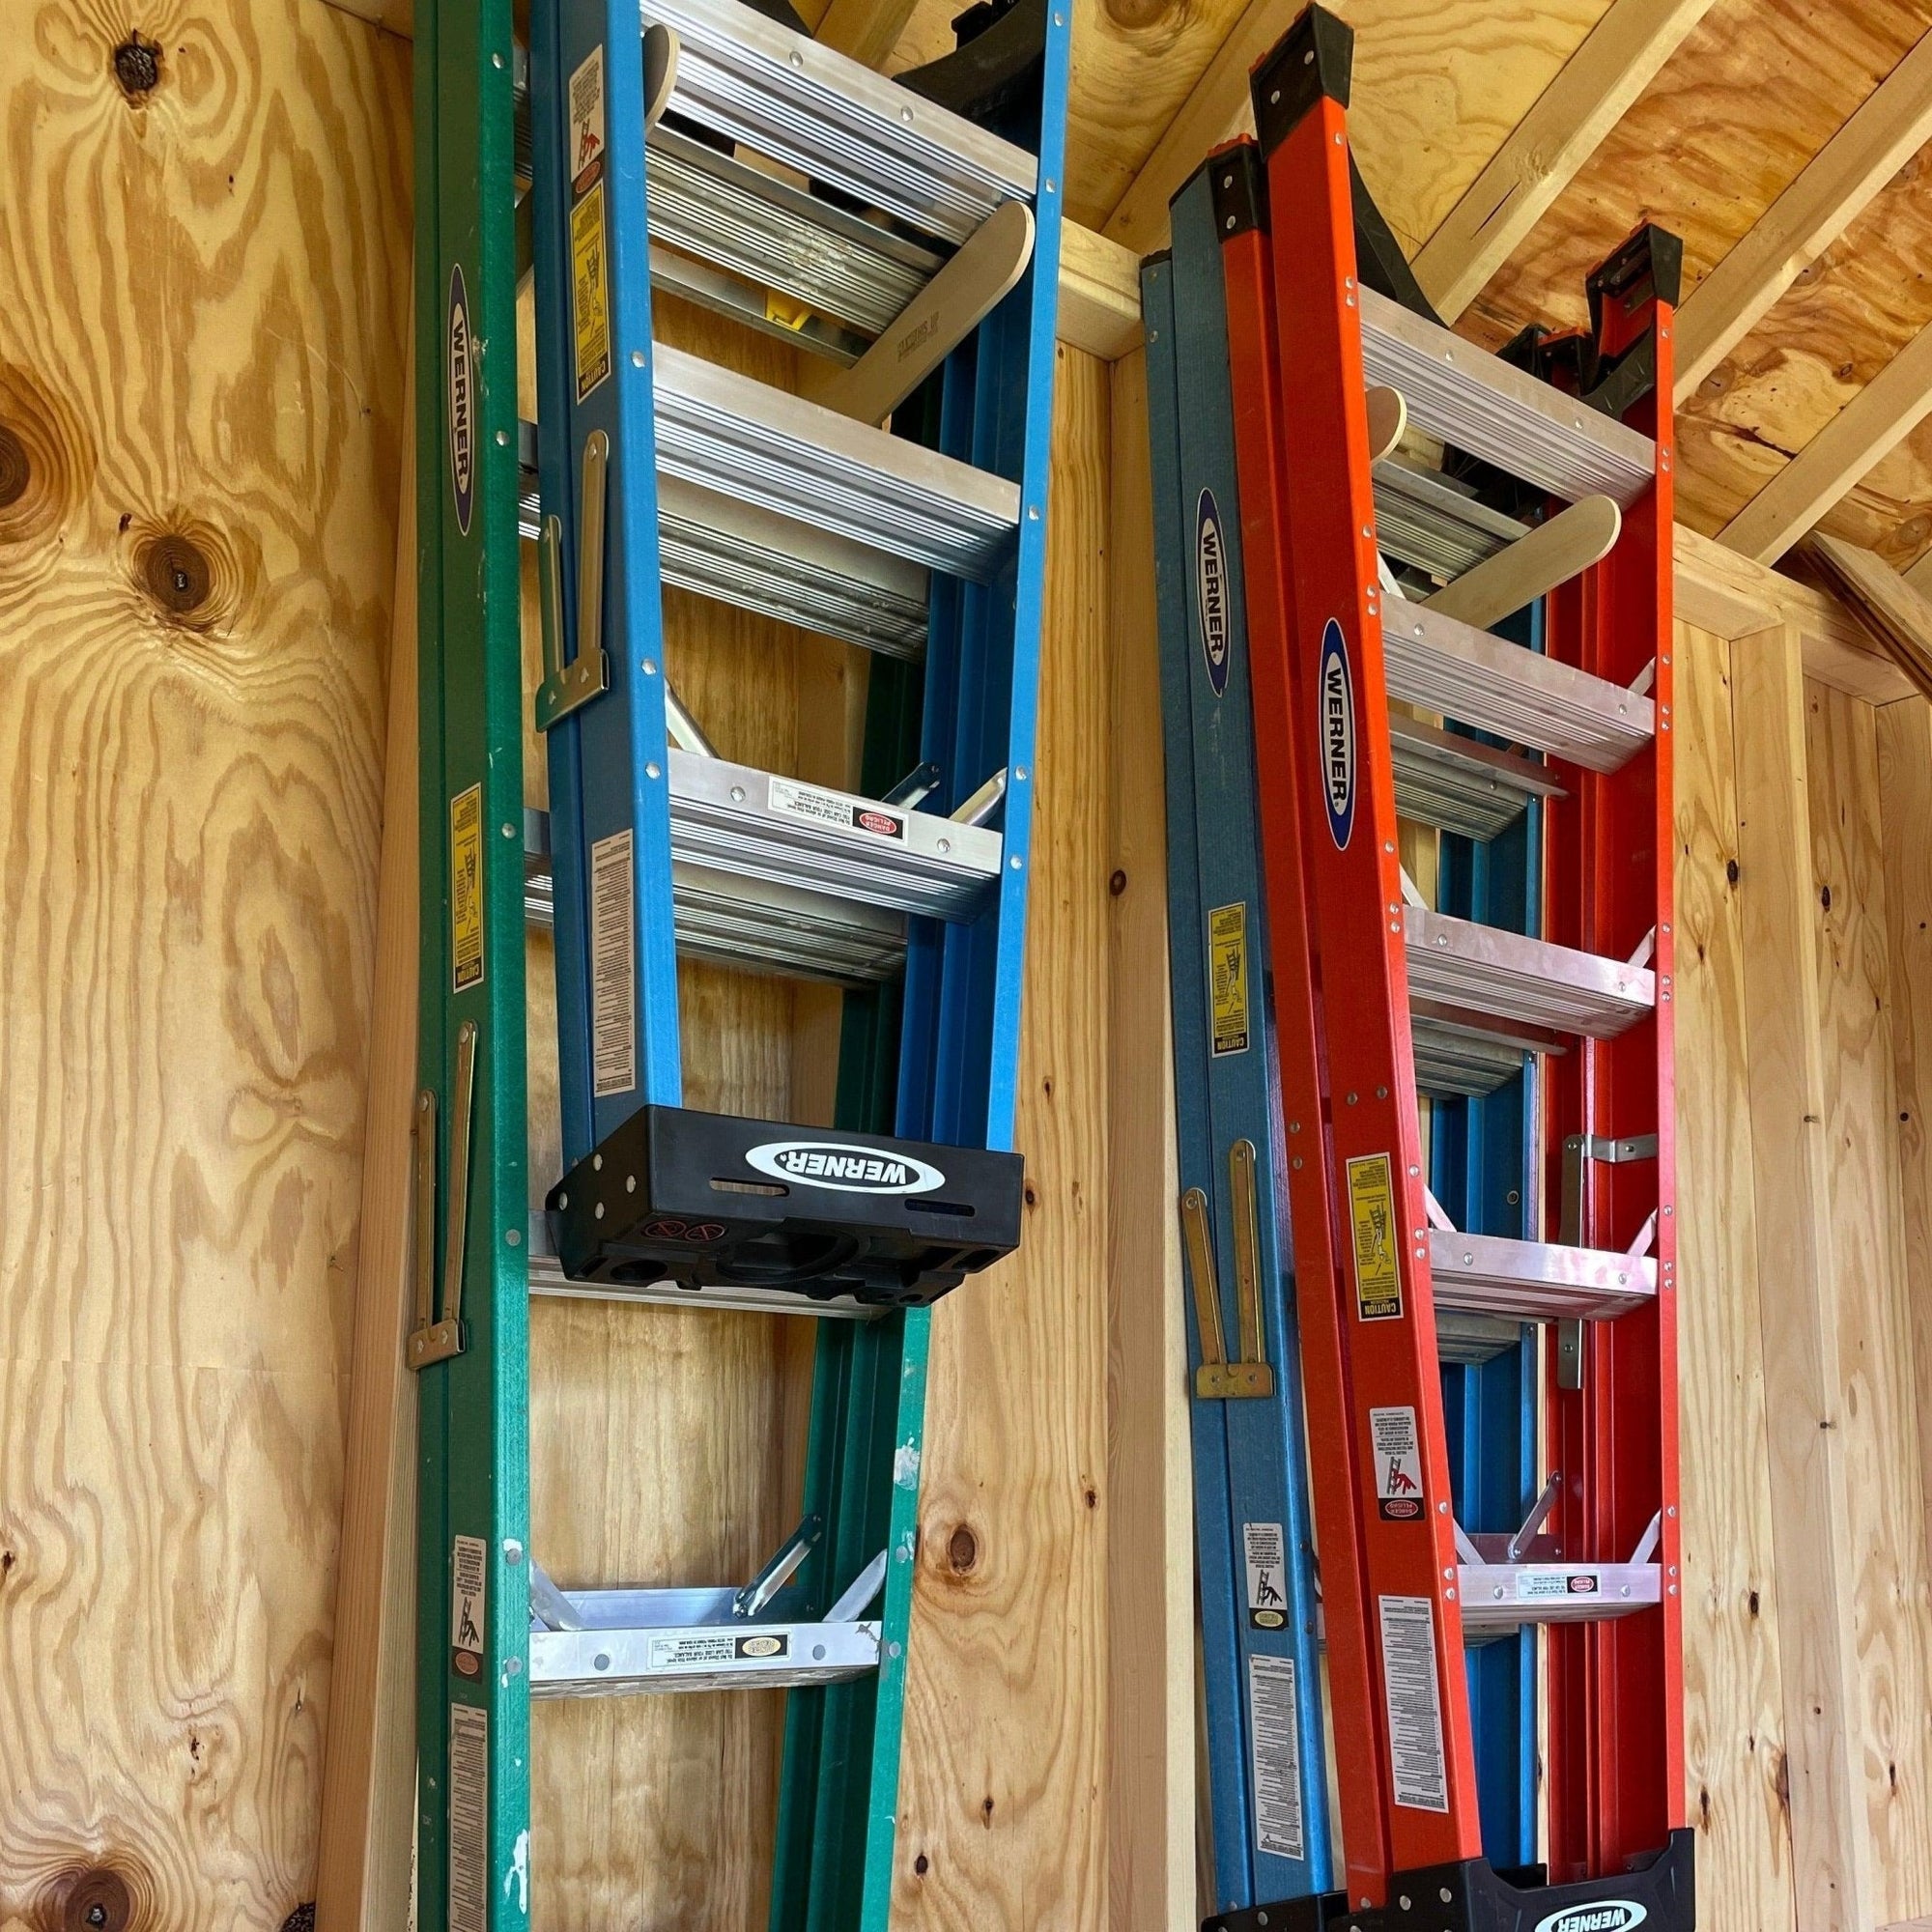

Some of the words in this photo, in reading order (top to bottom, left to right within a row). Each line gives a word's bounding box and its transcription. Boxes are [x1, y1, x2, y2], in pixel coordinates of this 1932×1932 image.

[454, 320, 469, 481] WERNER
[1204, 531, 1223, 653] WERNER
[1327, 668, 1348, 801] WERNER
[1217, 1037, 1244, 1050] CAUTION
[788, 1151, 906, 1184] WERNER
[1365, 1302, 1396, 1315] CAUTION
[1557, 1909, 1625, 1932] WERNER
